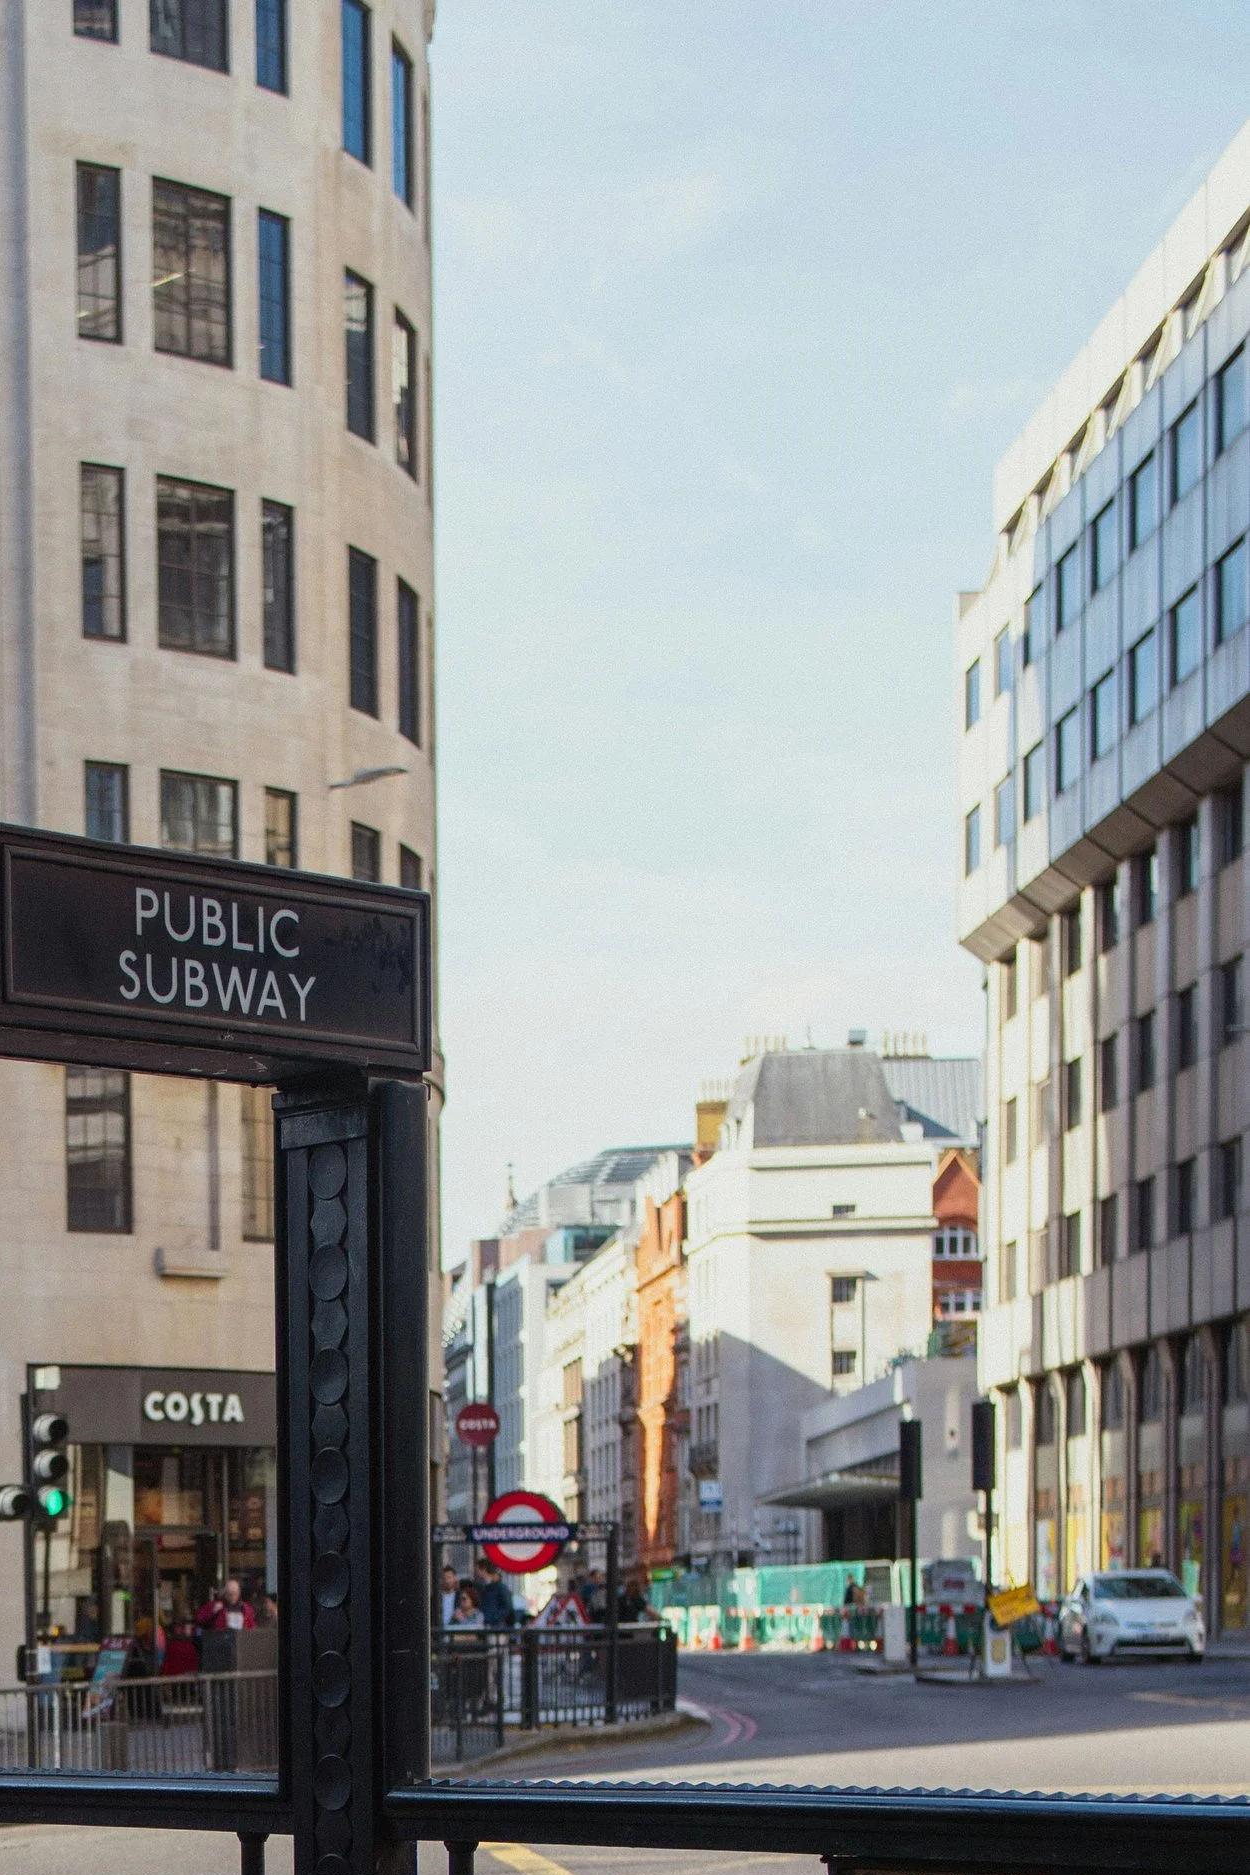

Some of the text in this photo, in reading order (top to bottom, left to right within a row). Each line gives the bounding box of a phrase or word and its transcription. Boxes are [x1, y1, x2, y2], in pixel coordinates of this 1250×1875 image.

[135, 886, 300, 958] PUBLIC
[119, 949, 317, 1022] SUBWAY
[144, 1390, 245, 1426] COSTA
[459, 1417, 496, 1431] COSTA
[472, 1525, 569, 1540] UNDERGROUND
